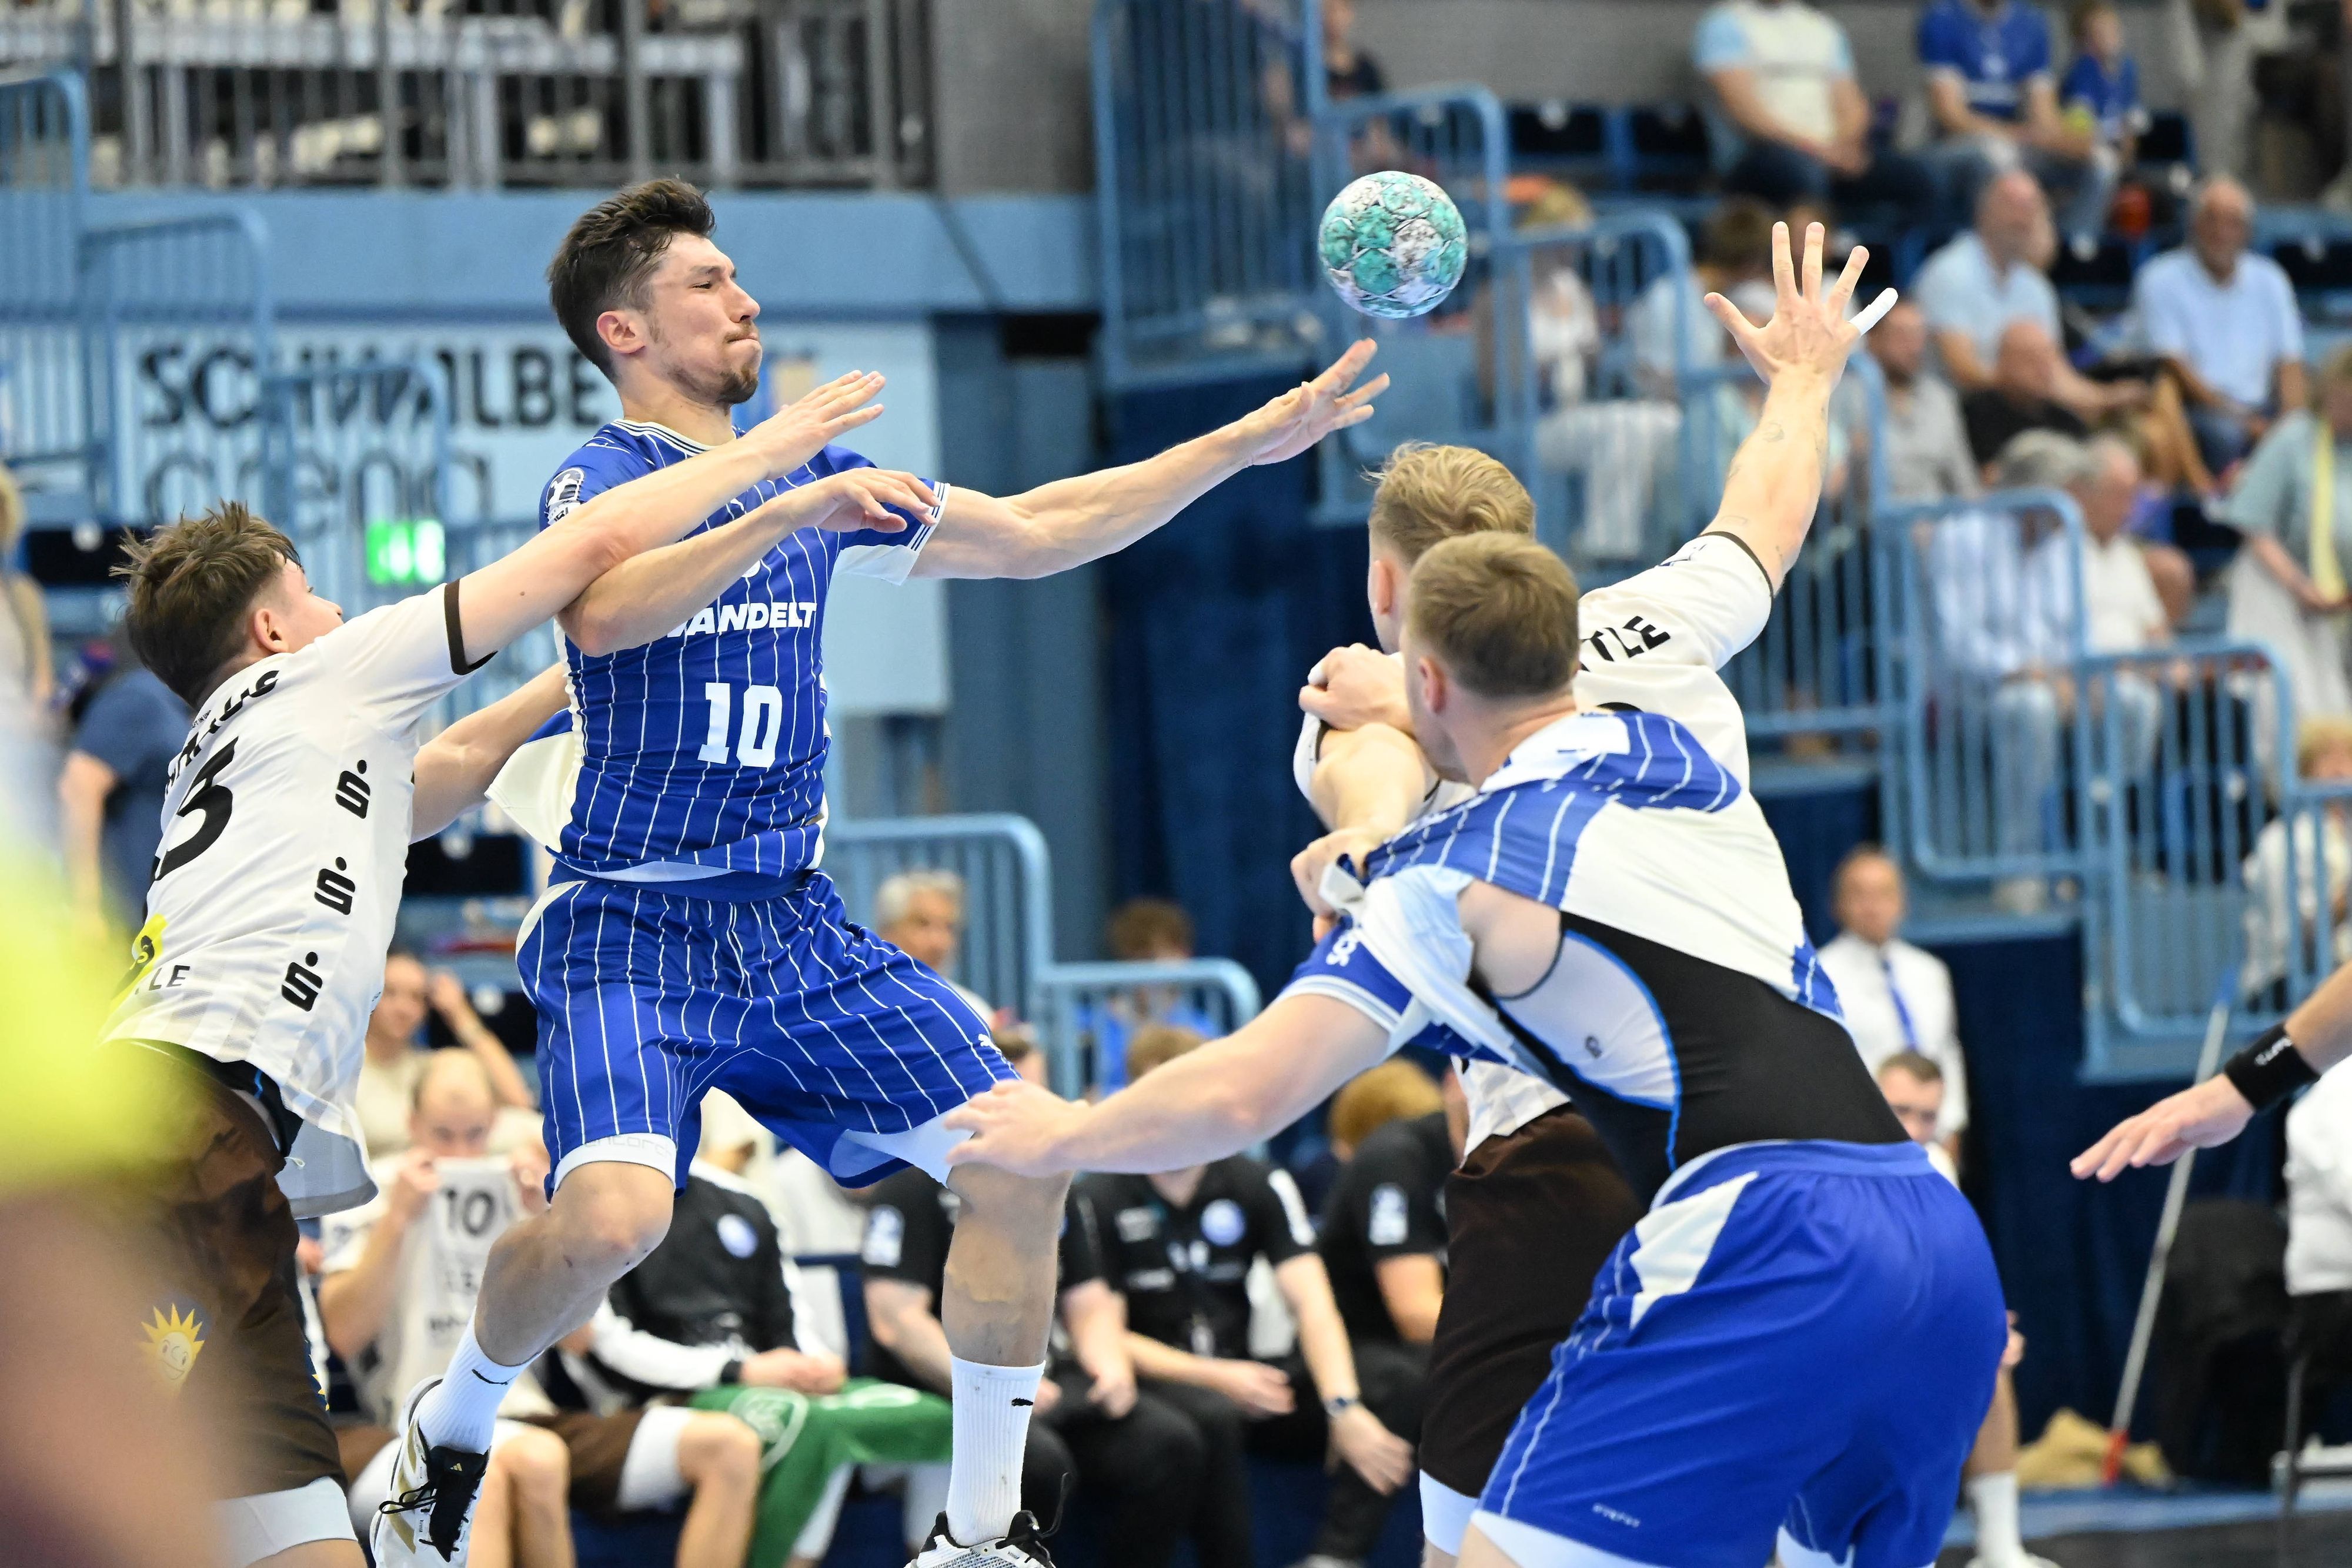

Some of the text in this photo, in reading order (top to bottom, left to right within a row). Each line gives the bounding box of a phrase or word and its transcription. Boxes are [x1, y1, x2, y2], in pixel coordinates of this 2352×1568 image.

[1581, 616, 1671, 672] TLE
[697, 683, 782, 767] 10
[438, 1184, 497, 1238] 10
